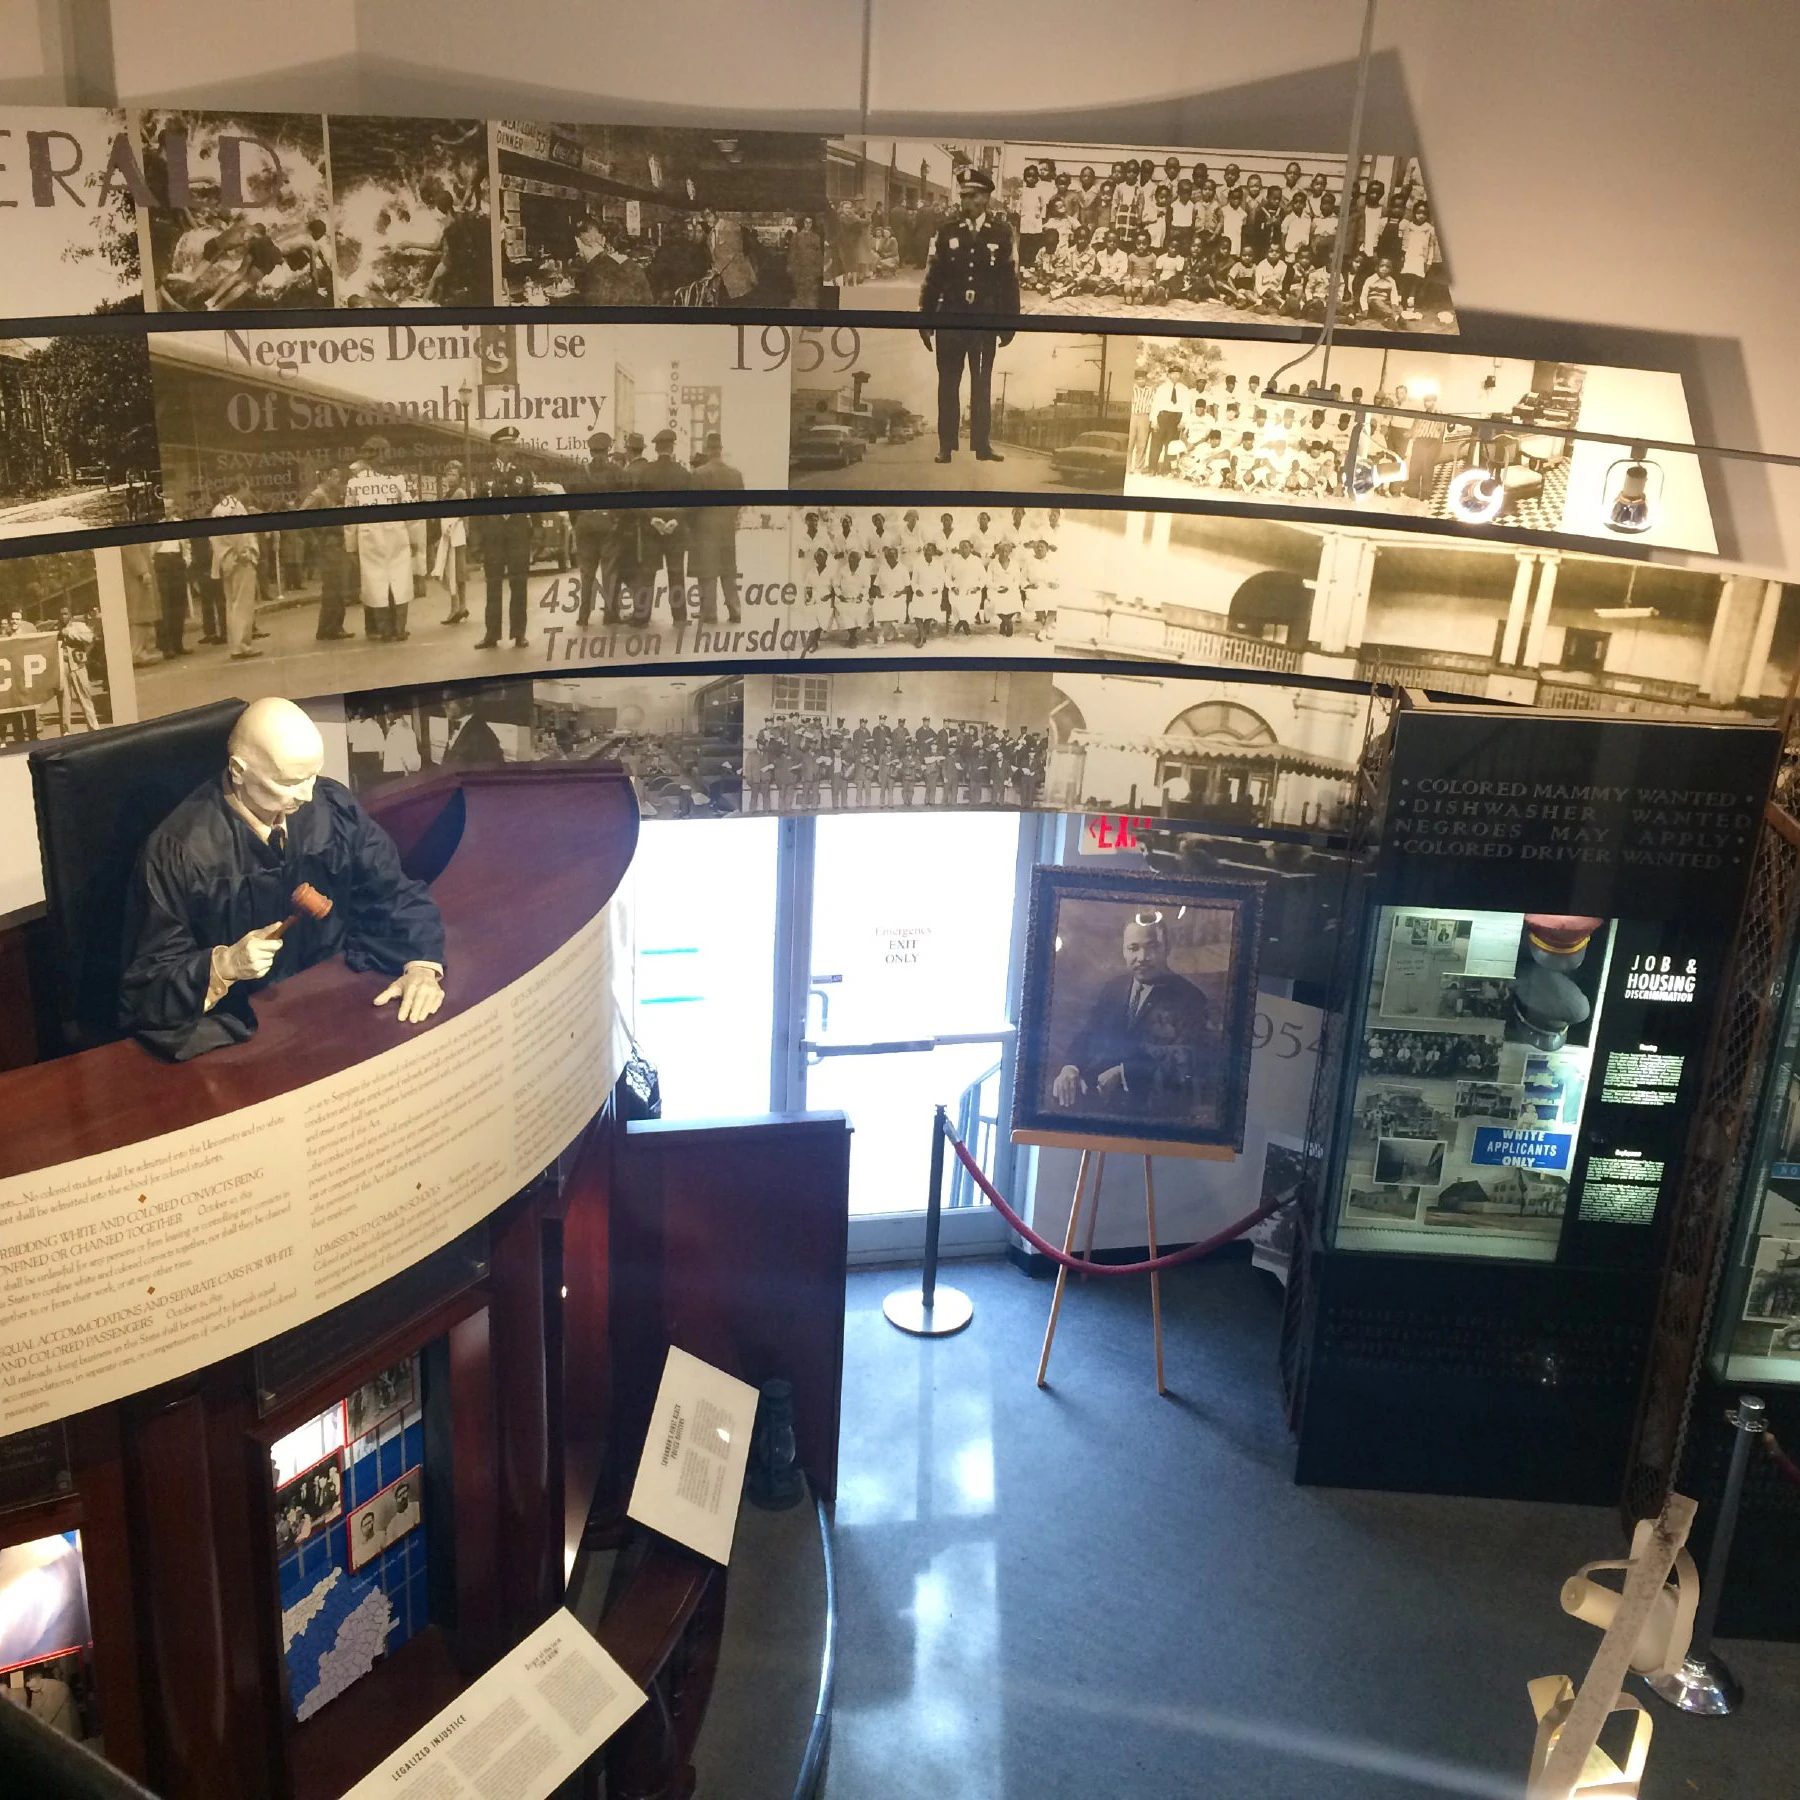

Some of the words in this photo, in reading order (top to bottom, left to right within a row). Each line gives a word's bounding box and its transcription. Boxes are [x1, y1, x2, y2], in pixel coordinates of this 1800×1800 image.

[224, 330, 374, 380] Negroes
[526, 325, 586, 358] Use
[730, 325, 861, 373] 1959
[227, 392, 279, 433] Of
[290, 386, 465, 430] Savannah
[476, 384, 607, 432] Library
[556, 436, 589, 450] Libr
[345, 482, 398, 497] arence
[539, 577, 582, 614] 43
[543, 622, 617, 662] Trial
[626, 632, 662, 657] on
[675, 614, 812, 659] Thursday
[1417, 777, 1528, 798] COLORED
[1534, 784, 1628, 802] MAMMY
[1637, 788, 1738, 808] WANTED
[1412, 799, 1598, 823] DISHWASHER
[1631, 808, 1752, 829] WANTED
[1395, 818, 1523, 838] NEGROES
[1550, 825, 1610, 843] MAY
[1638, 829, 1731, 847] APPLY
[1404, 838, 1513, 859] COLORED
[1520, 844, 1614, 864] DRIVER
[1622, 848, 1723, 869] WANTED
[885, 953, 919, 964] ONLY
[889, 939, 919, 949] EXIT
[1626, 973, 1696, 993] HOUSING
[1487, 1141, 1557, 1157] APPLICANTS
[1502, 1128, 1545, 1142] WHITE
[1502, 1156, 1536, 1168] ONLY
[59, 1222, 98, 1245] WHITE
[99, 1214, 125, 1233] AND
[126, 1197, 178, 1225] COLORED
[180, 1178, 233, 1208] CONVICTS
[234, 1166, 264, 1189] BEING
[0, 1252, 48, 1275] NFINED
[51, 1247, 68, 1262] OR
[70, 1231, 123, 1257] CHAINED
[125, 1212, 182, 1241] TOGETHER
[38, 1303, 142, 1347] ACCOMMODATIONS
[144, 1294, 168, 1314] AND
[169, 1276, 216, 1305] SEPARATE
[217, 1264, 244, 1286] CARS
[245, 1257, 263, 1275] FOR
[264, 1243, 294, 1267] WHITE
[29, 1338, 84, 1366] COLORED
[86, 1315, 153, 1349] PASSENGERS
[391, 1746, 431, 1782] LEGALIZED
[431, 1713, 467, 1750] INJUSTICE
